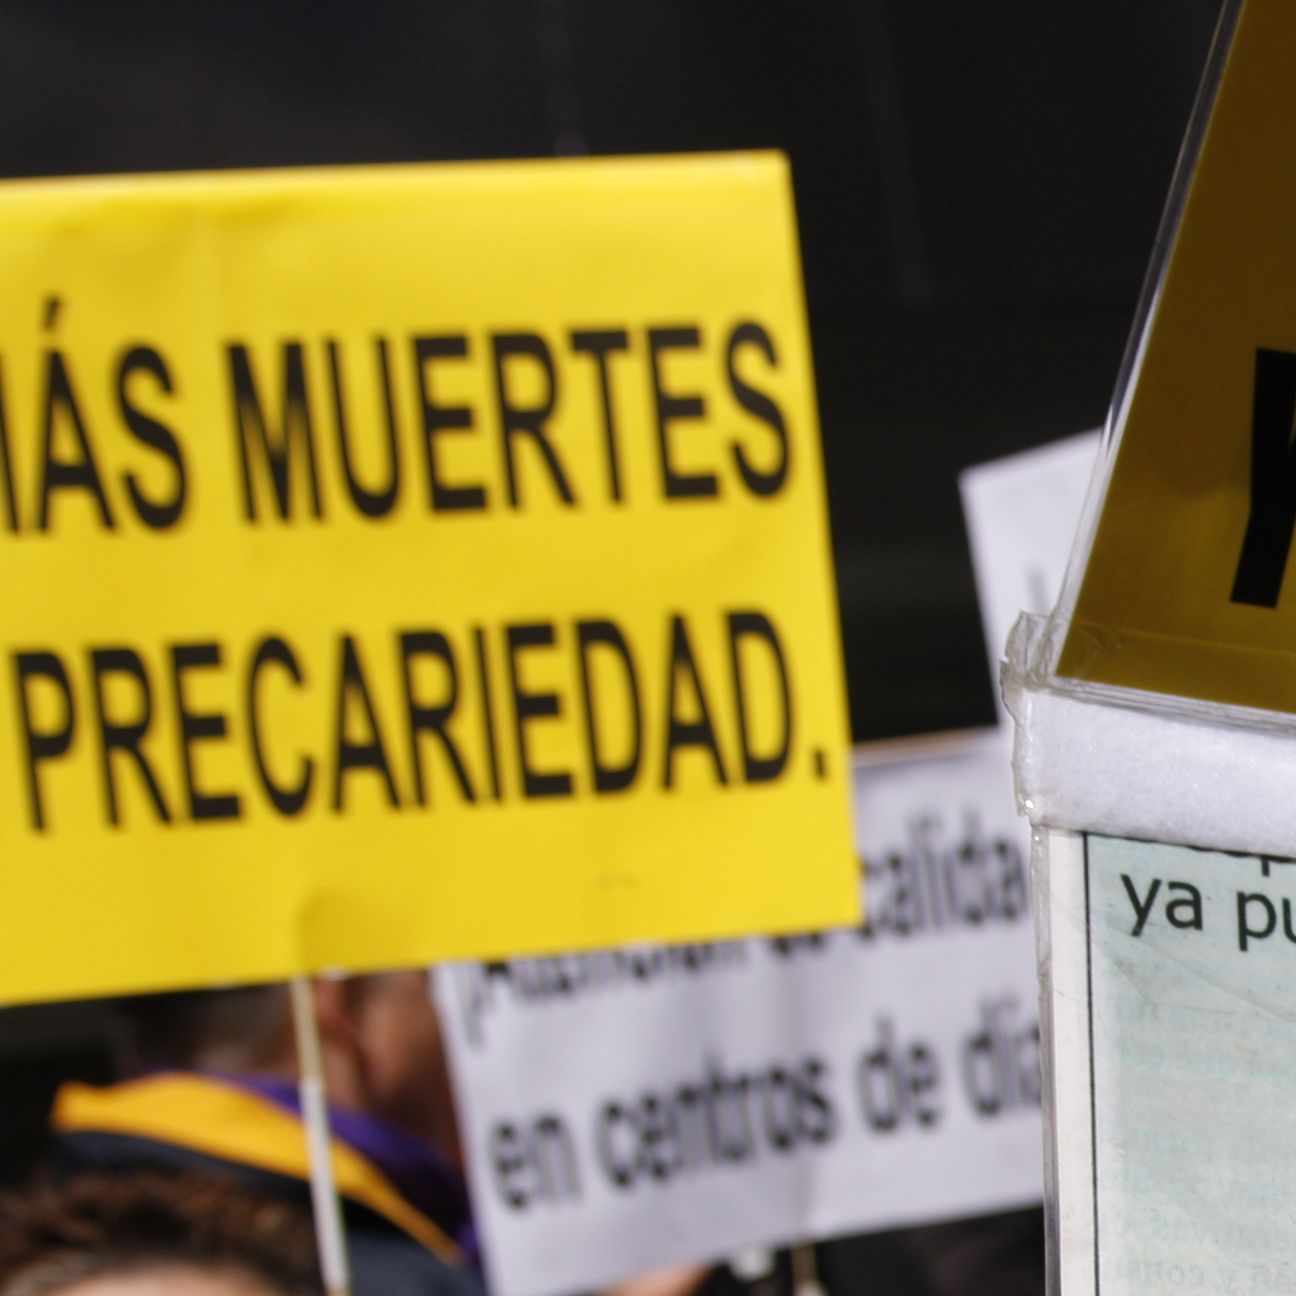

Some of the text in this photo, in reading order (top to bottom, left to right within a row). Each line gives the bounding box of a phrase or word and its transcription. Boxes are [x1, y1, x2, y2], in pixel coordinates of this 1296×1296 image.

[0, 292, 796, 535] ÁS MUERTES
[10, 608, 831, 837] PRECARIEDAD.
[1120, 873, 1204, 937] ya
[485, 1108, 583, 1211] en
[595, 1052, 838, 1190] centros
[857, 1012, 942, 1135] de
